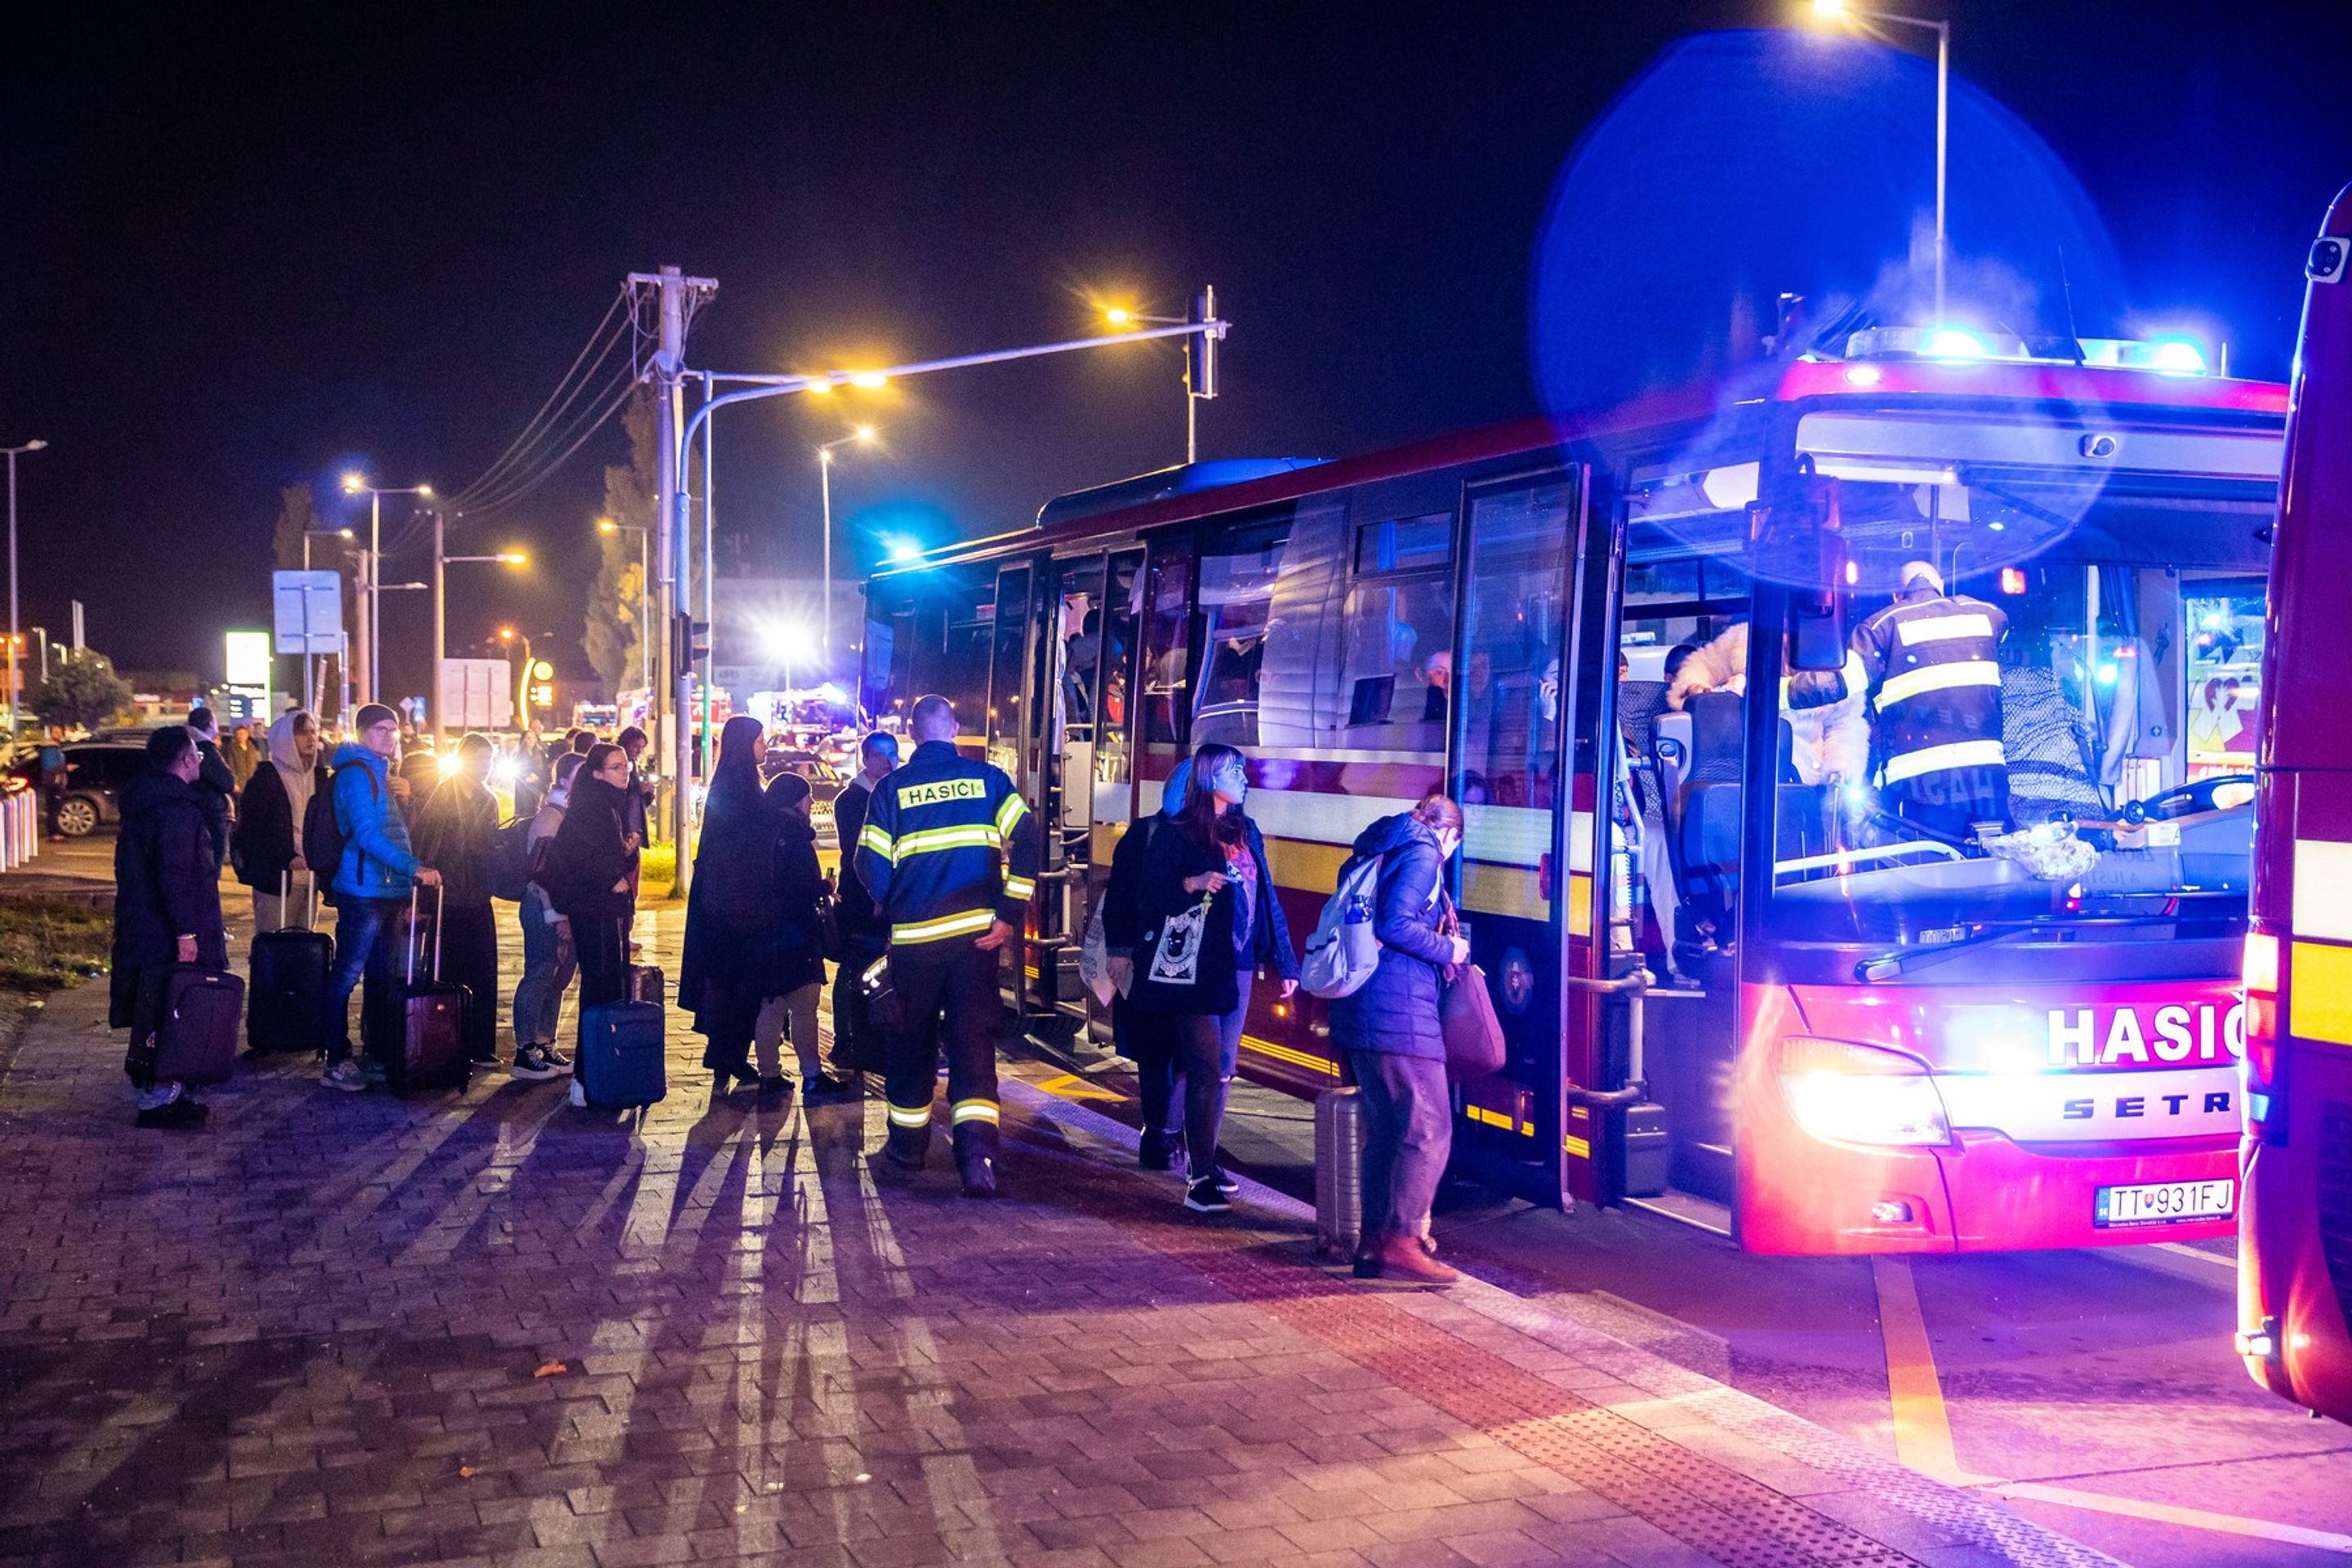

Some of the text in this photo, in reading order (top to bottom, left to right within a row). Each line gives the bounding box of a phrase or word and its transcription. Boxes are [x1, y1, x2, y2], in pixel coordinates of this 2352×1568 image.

[910, 781, 975, 804] HASIČI
[2114, 1183, 2230, 1216] TT 931FJ
